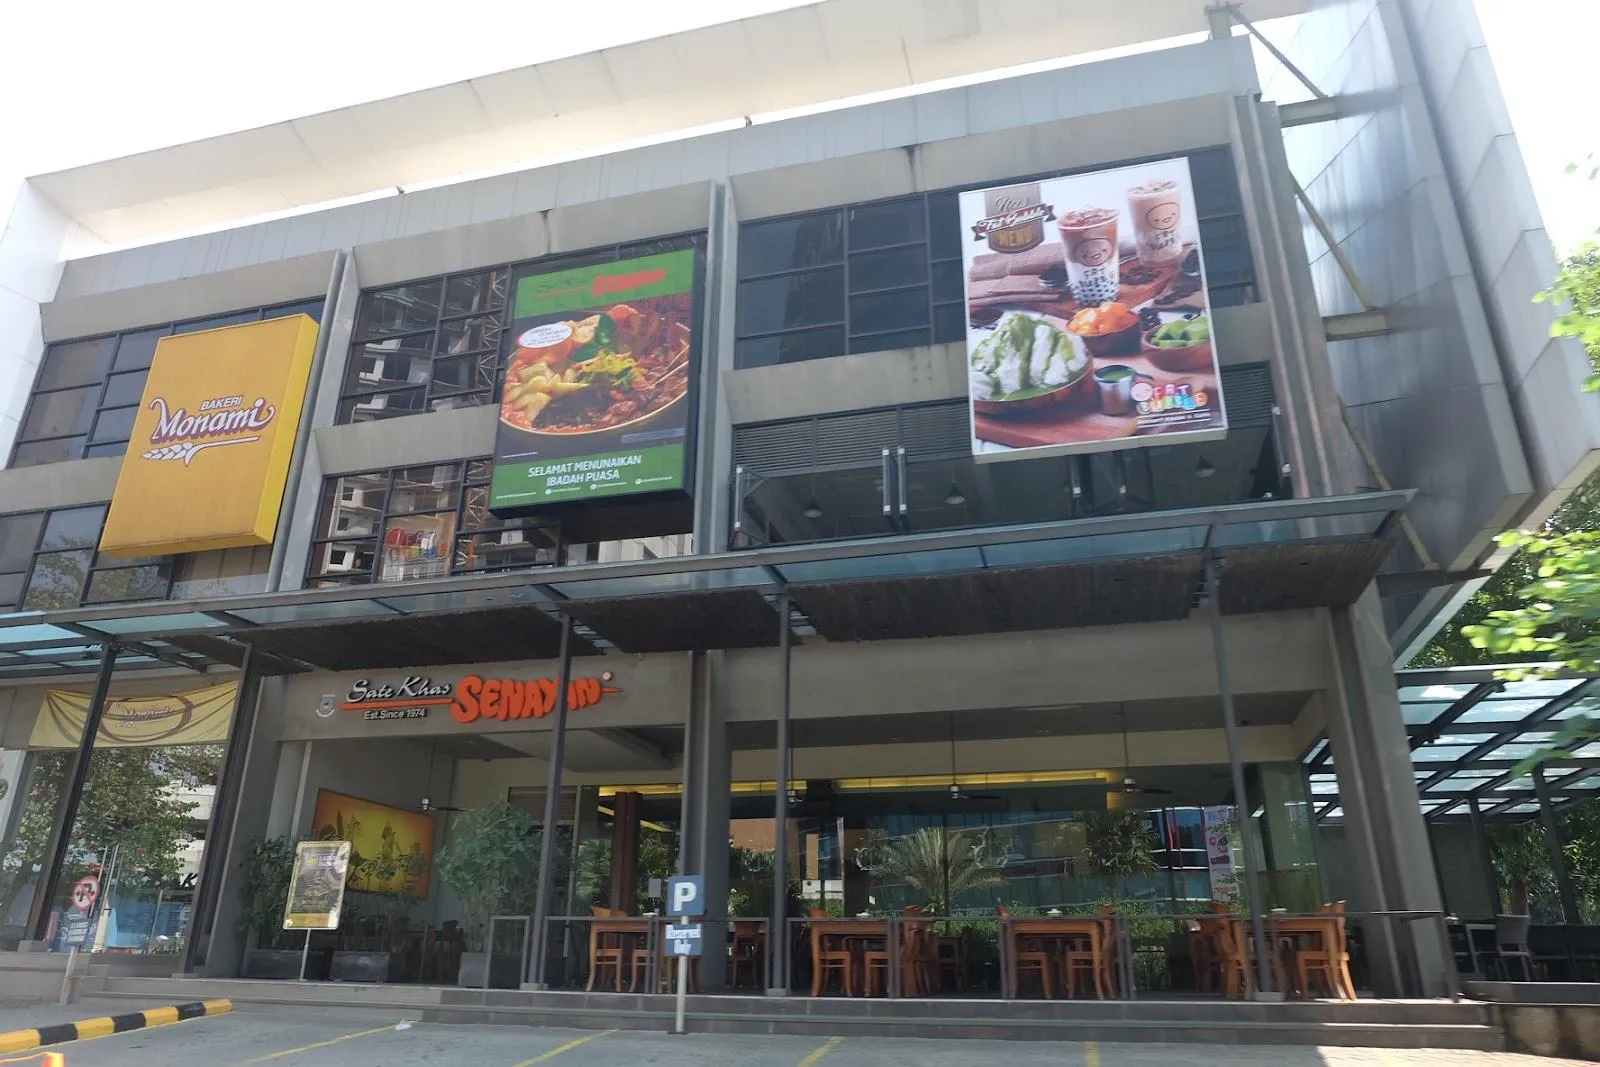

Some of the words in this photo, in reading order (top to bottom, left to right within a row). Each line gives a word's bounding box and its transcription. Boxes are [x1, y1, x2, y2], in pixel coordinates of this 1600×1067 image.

[200, 395, 243, 411] BAKERI
[150, 398, 276, 444] Monami
[528, 462, 573, 478] SELAMAT
[574, 454, 643, 472] MENUNAIKAN
[546, 472, 584, 487] IBADAH
[585, 468, 620, 483] PUASA
[346, 679, 394, 703] Sate
[396, 676, 451, 697] Khas
[406, 707, 426, 719] 1974
[673, 882, 697, 912] P
